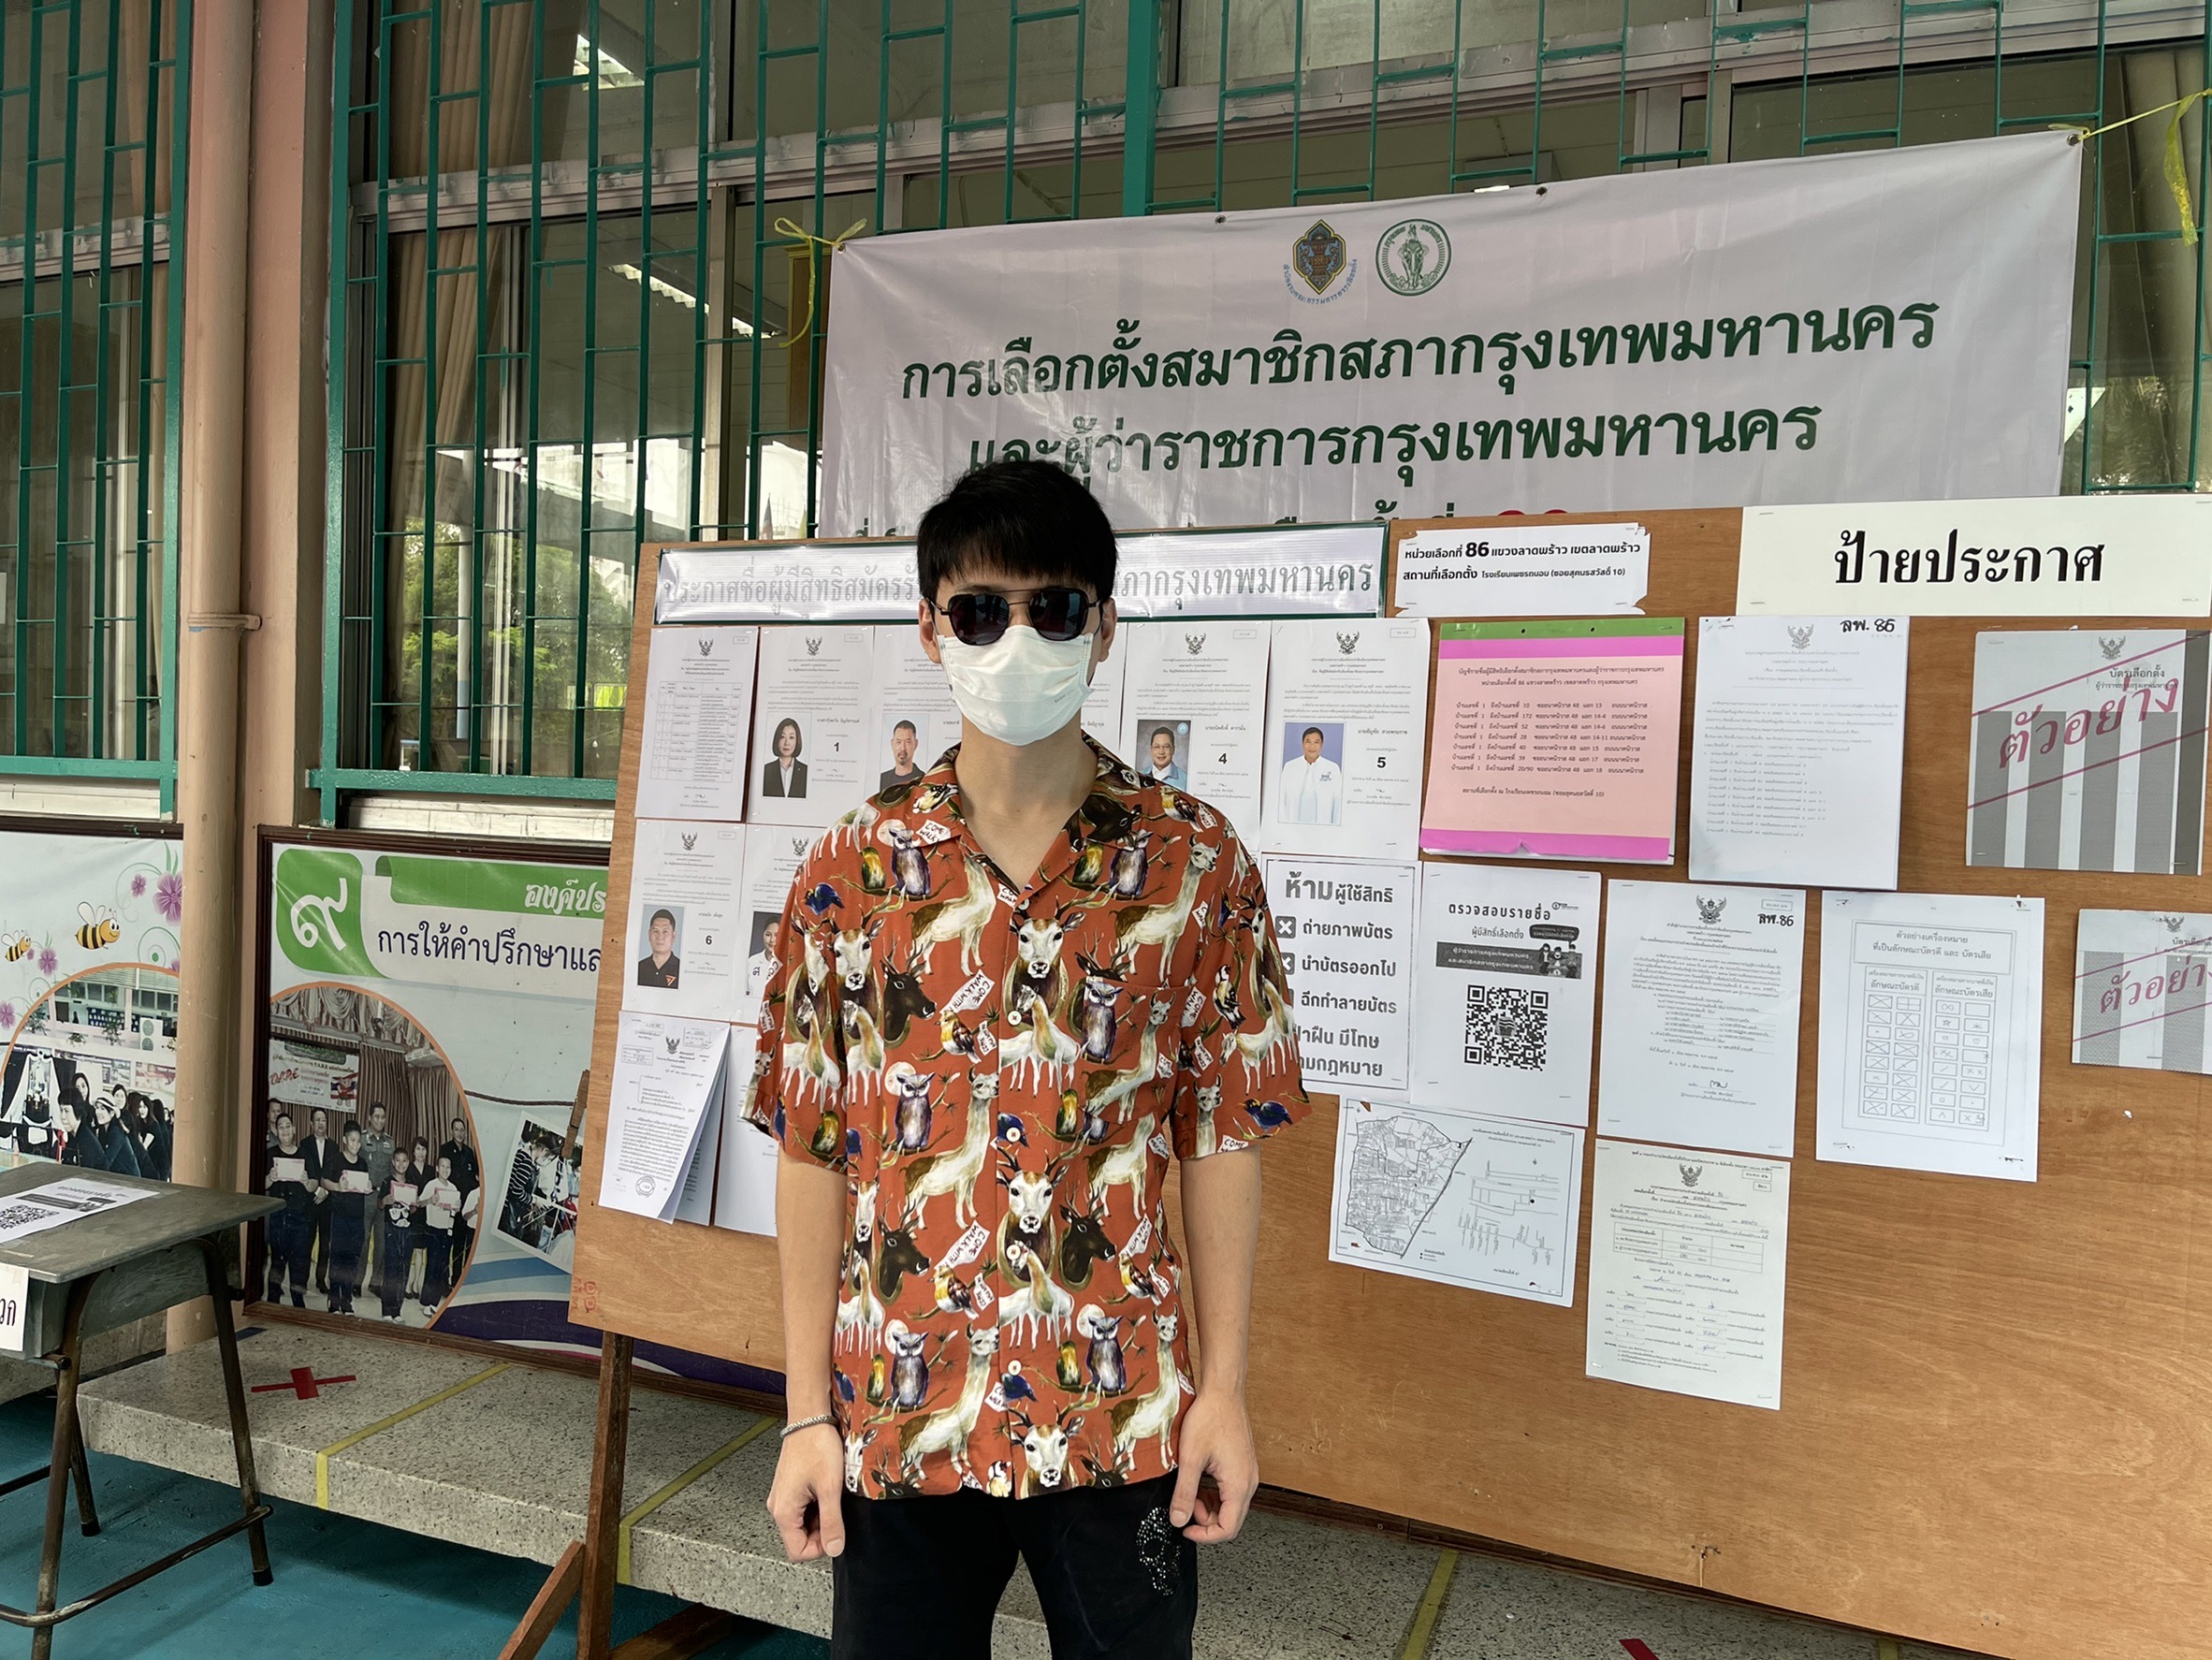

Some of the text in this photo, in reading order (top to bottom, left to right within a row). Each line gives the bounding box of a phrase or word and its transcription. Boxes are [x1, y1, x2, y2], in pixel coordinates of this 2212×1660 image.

[902, 299, 1938, 398] การเลือกตั้งสมาชิกสภากรุงเทพมหานคร
[969, 401, 1821, 492] และผู้ว่าราชการกรุงเทพมหานคร
[1404, 541, 1640, 559] หน่วยเลือกที่ 86 แขวงลาดพร้าว เขตลาดพร้าว
[1834, 528, 2105, 583] ป้ายประกาศ
[1404, 565, 1477, 580] สถานที่เลือกตั้ง
[663, 556, 1375, 616] ประกาศชื่อผู้มีสิทธิสมัครรั ภากรุงเทพมหานคร
[2109, 664, 2165, 677] บัตรเลือกตั้ง
[1999, 676, 2179, 769] ตัวอย่าง
[833, 742, 840, 752] 1
[1218, 752, 1228, 764] 4
[1376, 756, 1387, 768] 5
[924, 823, 945, 835] COME
[1285, 871, 1393, 906] ห้าม ผู้ใช้สิทธิ
[290, 877, 347, 951] ๙
[1448, 903, 1551, 921] ตรวจสอบรายชื่อ
[706, 936, 713, 945] 6
[1302, 921, 1393, 940] ถ่ายภาพบัตร
[1896, 930, 1969, 943] ตัวอย่างเครื่องหมาย
[378, 921, 601, 972] การให้คำปรึกษาแล
[1872, 940, 1942, 955] ที่เป็นลักษณะบัตรดี
[1961, 949, 1992, 959] บัตรเสีย
[1302, 954, 1397, 977] นำบัตรออกไป
[972, 980, 991, 1004] COME
[2100, 954, 2212, 1013] ตัวอย่า
[1301, 991, 1398, 1014] ฉีกทำลายบัตร
[1339, 1028, 1380, 1049] มีโทษ
[1300, 1056, 1383, 1077] ามกฎหมาย
[968, 1231, 986, 1257] COME
